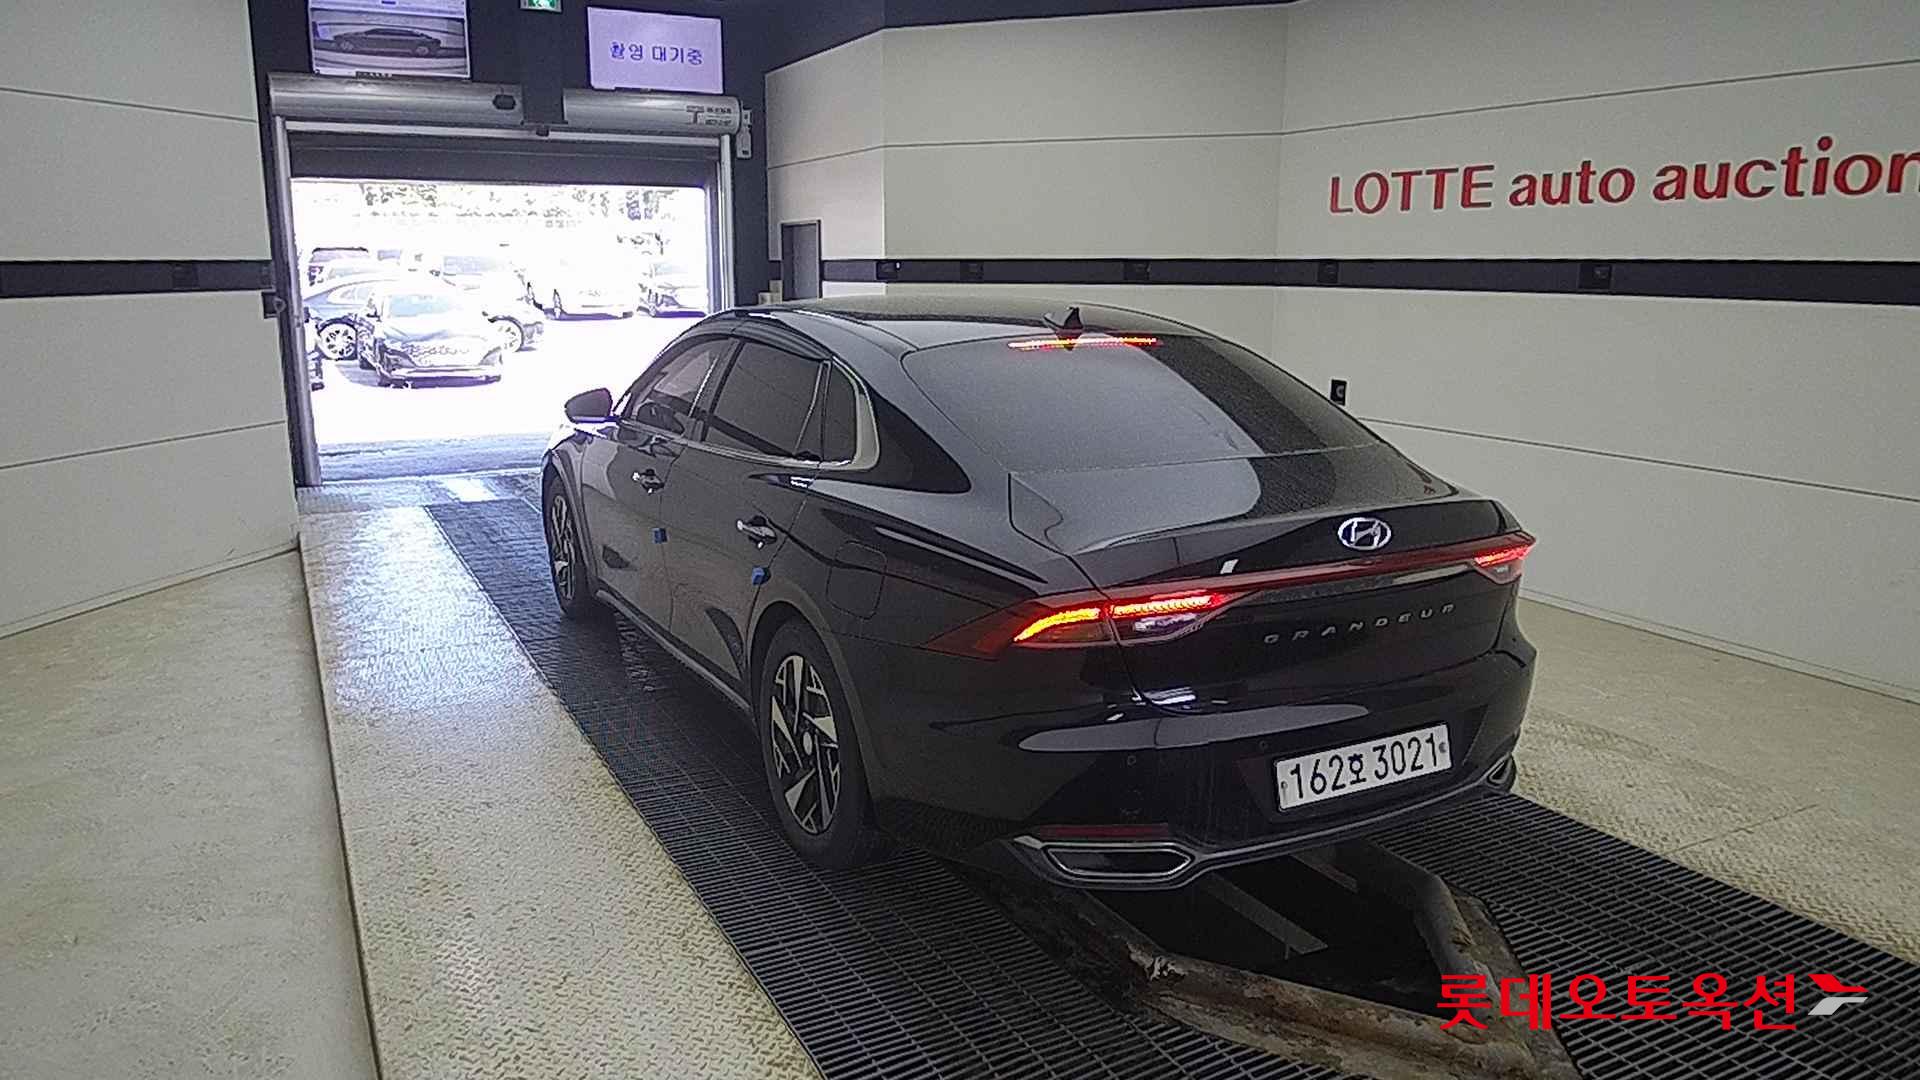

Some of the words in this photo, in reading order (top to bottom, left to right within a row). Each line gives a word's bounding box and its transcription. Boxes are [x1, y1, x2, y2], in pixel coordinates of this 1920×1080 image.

[652, 46, 703, 65] 대기중
[1329, 164, 1495, 214] LOTTE
[1509, 160, 1635, 207] auto
[1652, 136, 1920, 201] auction
[1264, 603, 1455, 644] GRANDEUR
